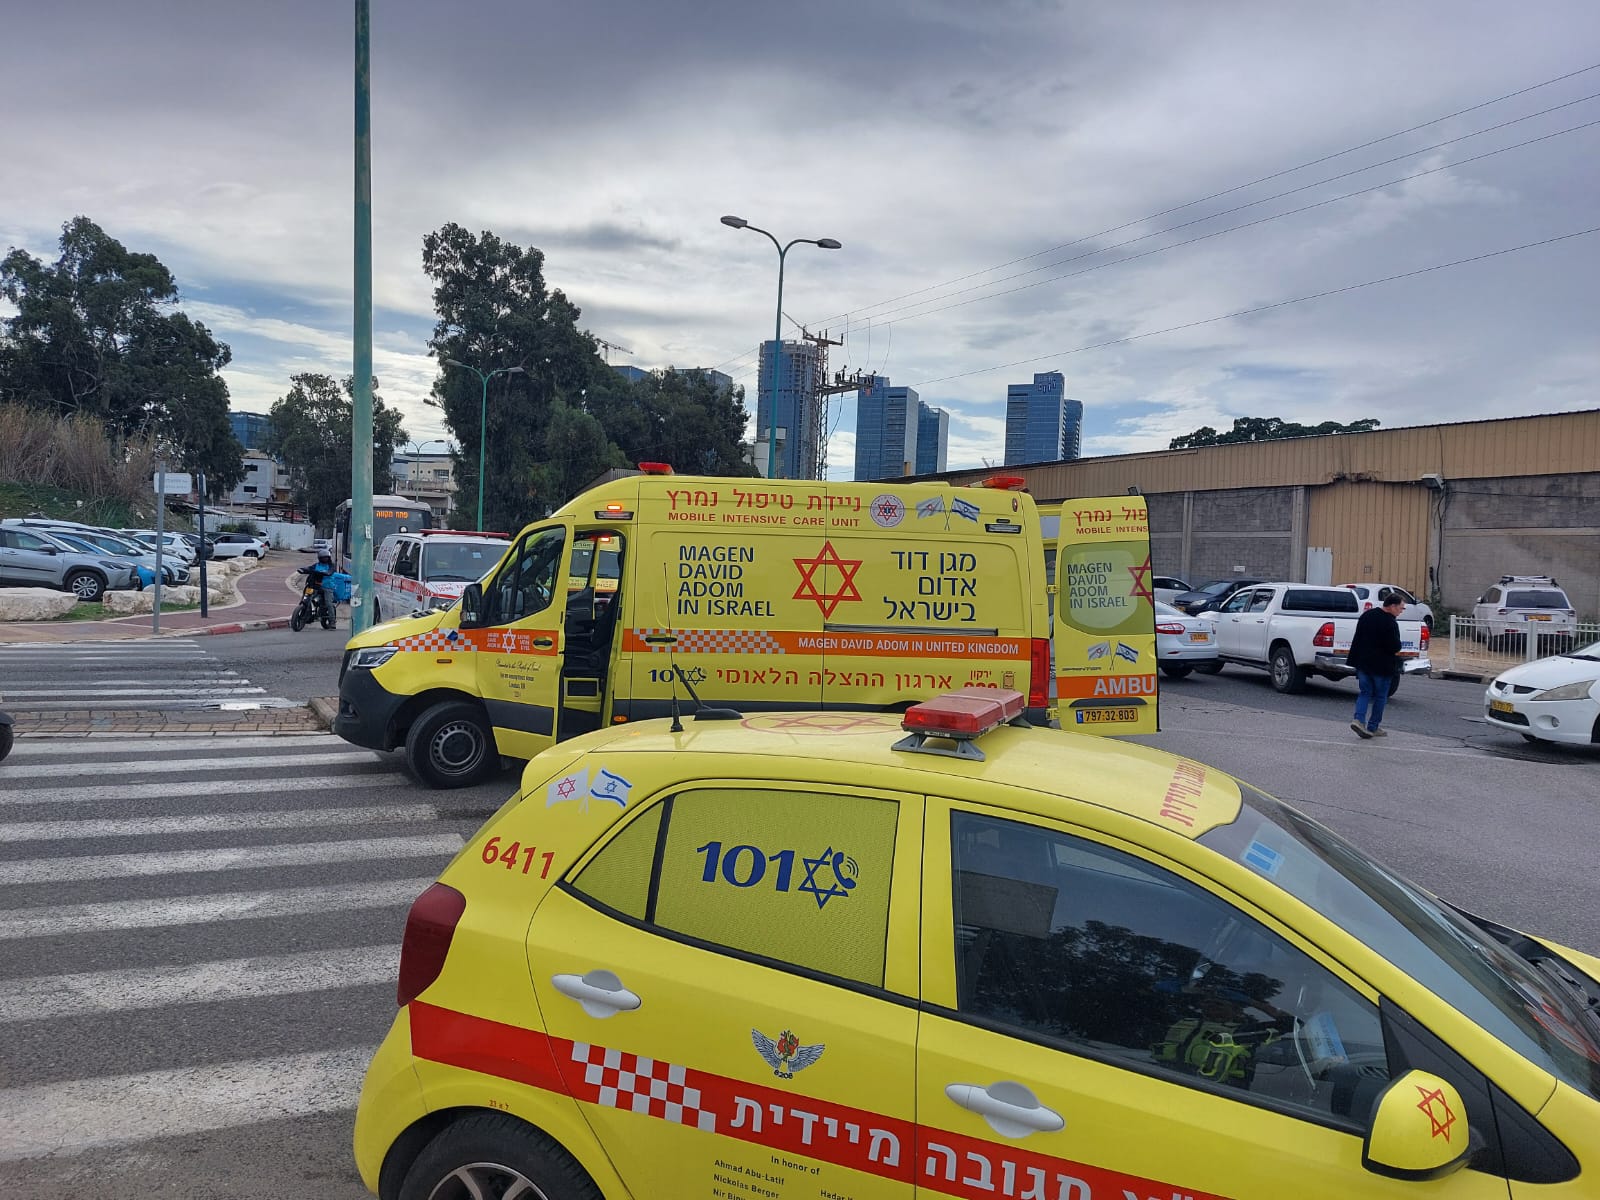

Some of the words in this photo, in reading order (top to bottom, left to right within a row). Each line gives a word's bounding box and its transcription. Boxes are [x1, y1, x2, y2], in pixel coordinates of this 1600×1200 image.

[666, 490, 718, 510] נמרץ
[733, 489, 794, 509] טיפול
[807, 495, 860, 512] ניידת
[668, 512, 716, 522] MOBILE
[722, 514, 786, 524] INTENSIVE
[793, 516, 825, 526] CARE
[832, 518, 860, 527] UNIT
[1073, 510, 1112, 526] נמרץ
[1076, 526, 1111, 534] MOBILE
[679, 546, 754, 562] MAGEN
[890, 551, 928, 570] דוד
[940, 552, 976, 574] מגן
[1068, 562, 1112, 574] MAGEN
[678, 564, 743, 580] DAVID
[1068, 574, 1106, 586] DAVID
[678, 582, 744, 598] ADOM
[918, 576, 976, 596] אדום
[1070, 586, 1108, 597] ADOM
[678, 600, 698, 615] IN
[708, 600, 775, 617] ISRAEL
[884, 596, 976, 622] בישראל
[1070, 598, 1082, 608] IN
[1088, 596, 1128, 608] ISRAEL
[798, 638, 838, 649] MAGEN
[841, 638, 874, 650] DAVID
[876, 640, 909, 651] ADOM
[912, 640, 923, 651] IN
[926, 642, 965, 653] UNITED
[968, 642, 1018, 654] KINGDOM
[716, 668, 798, 685] הלאומי
[808, 669, 884, 687] ההצלה
[896, 674, 952, 691] ארגון
[970, 670, 992, 680] ירקון
[1094, 676, 1155, 696] AMBU
[482, 836, 556, 880] 6411
[696, 841, 796, 893] 101
[730, 1095, 900, 1167] מיידית
[714, 1160, 743, 1174] Ahmad
[745, 1168, 785, 1186] Abu-Latif
[771, 1155, 780, 1164] In
[782, 1158, 808, 1172] honor
[810, 1168, 820, 1176] of
[926, 1142, 1092, 1200] תגובה
[713, 1188, 725, 1198] Nir
[714, 1174, 749, 1190] Nickolas
[751, 1185, 780, 1199] Berger
